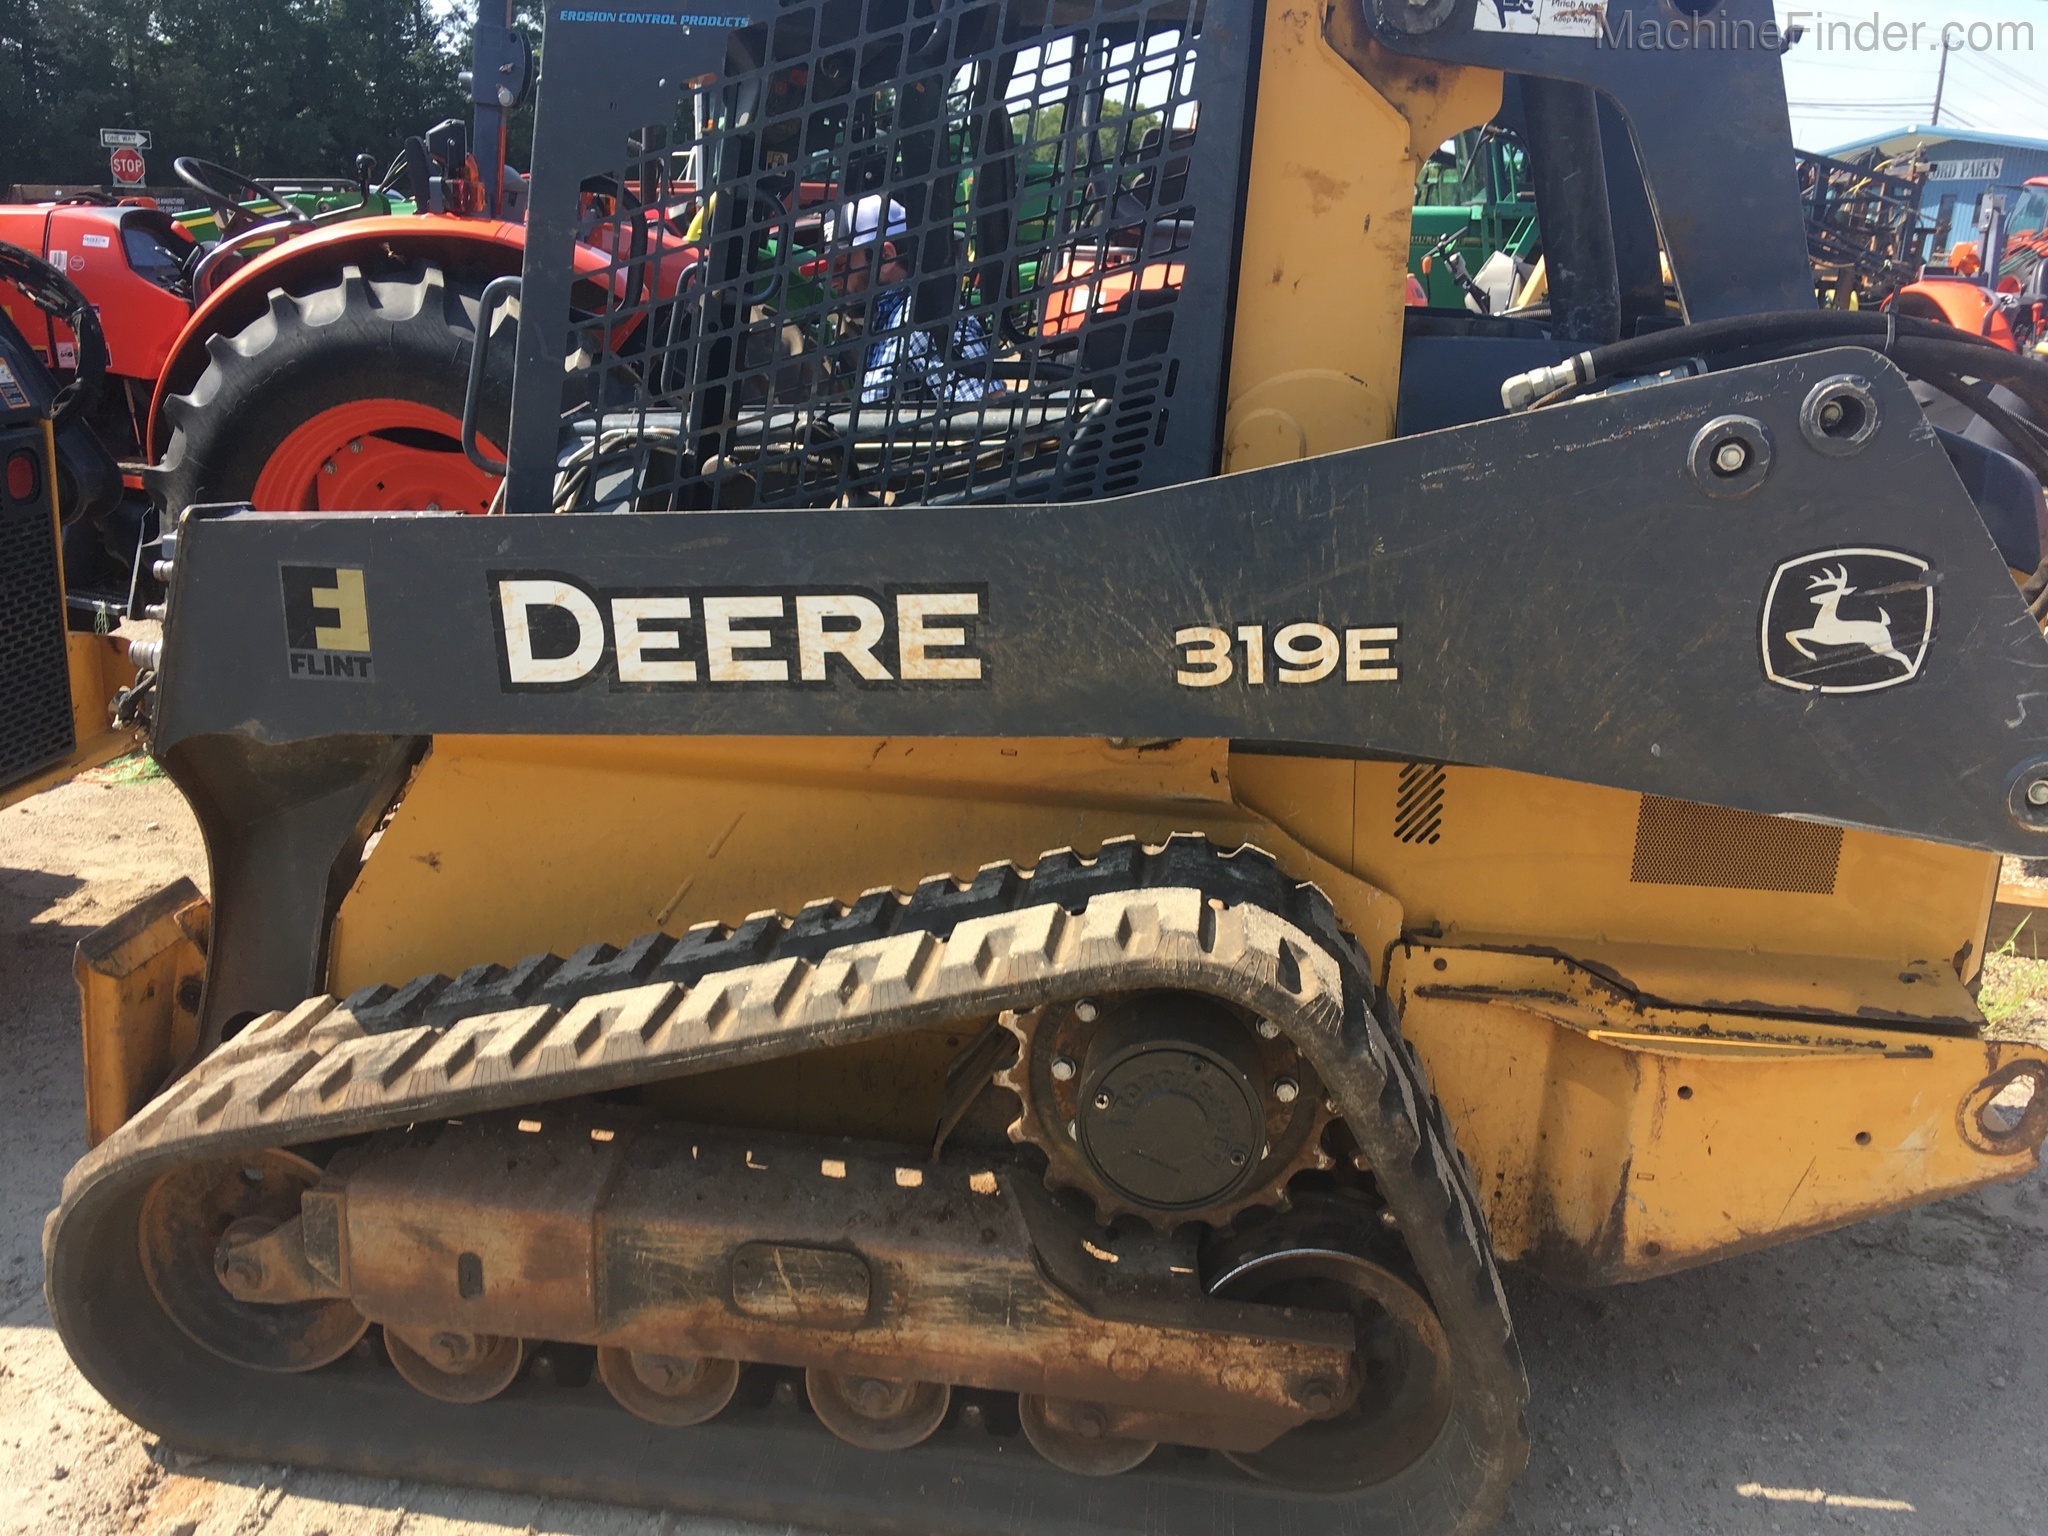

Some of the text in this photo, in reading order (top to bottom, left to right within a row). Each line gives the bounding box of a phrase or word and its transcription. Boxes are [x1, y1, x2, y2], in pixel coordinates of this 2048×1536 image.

[560, 10, 750, 28] EROSION CONTROL PRODUCTS
[1553, 15, 1592, 25] Keep Away
[113, 158, 142, 173] STOP
[1960, 160, 2000, 178] PARTS
[498, 580, 983, 684] DEERE
[1175, 622, 1399, 688] 319E
[290, 652, 372, 678] FLINT
